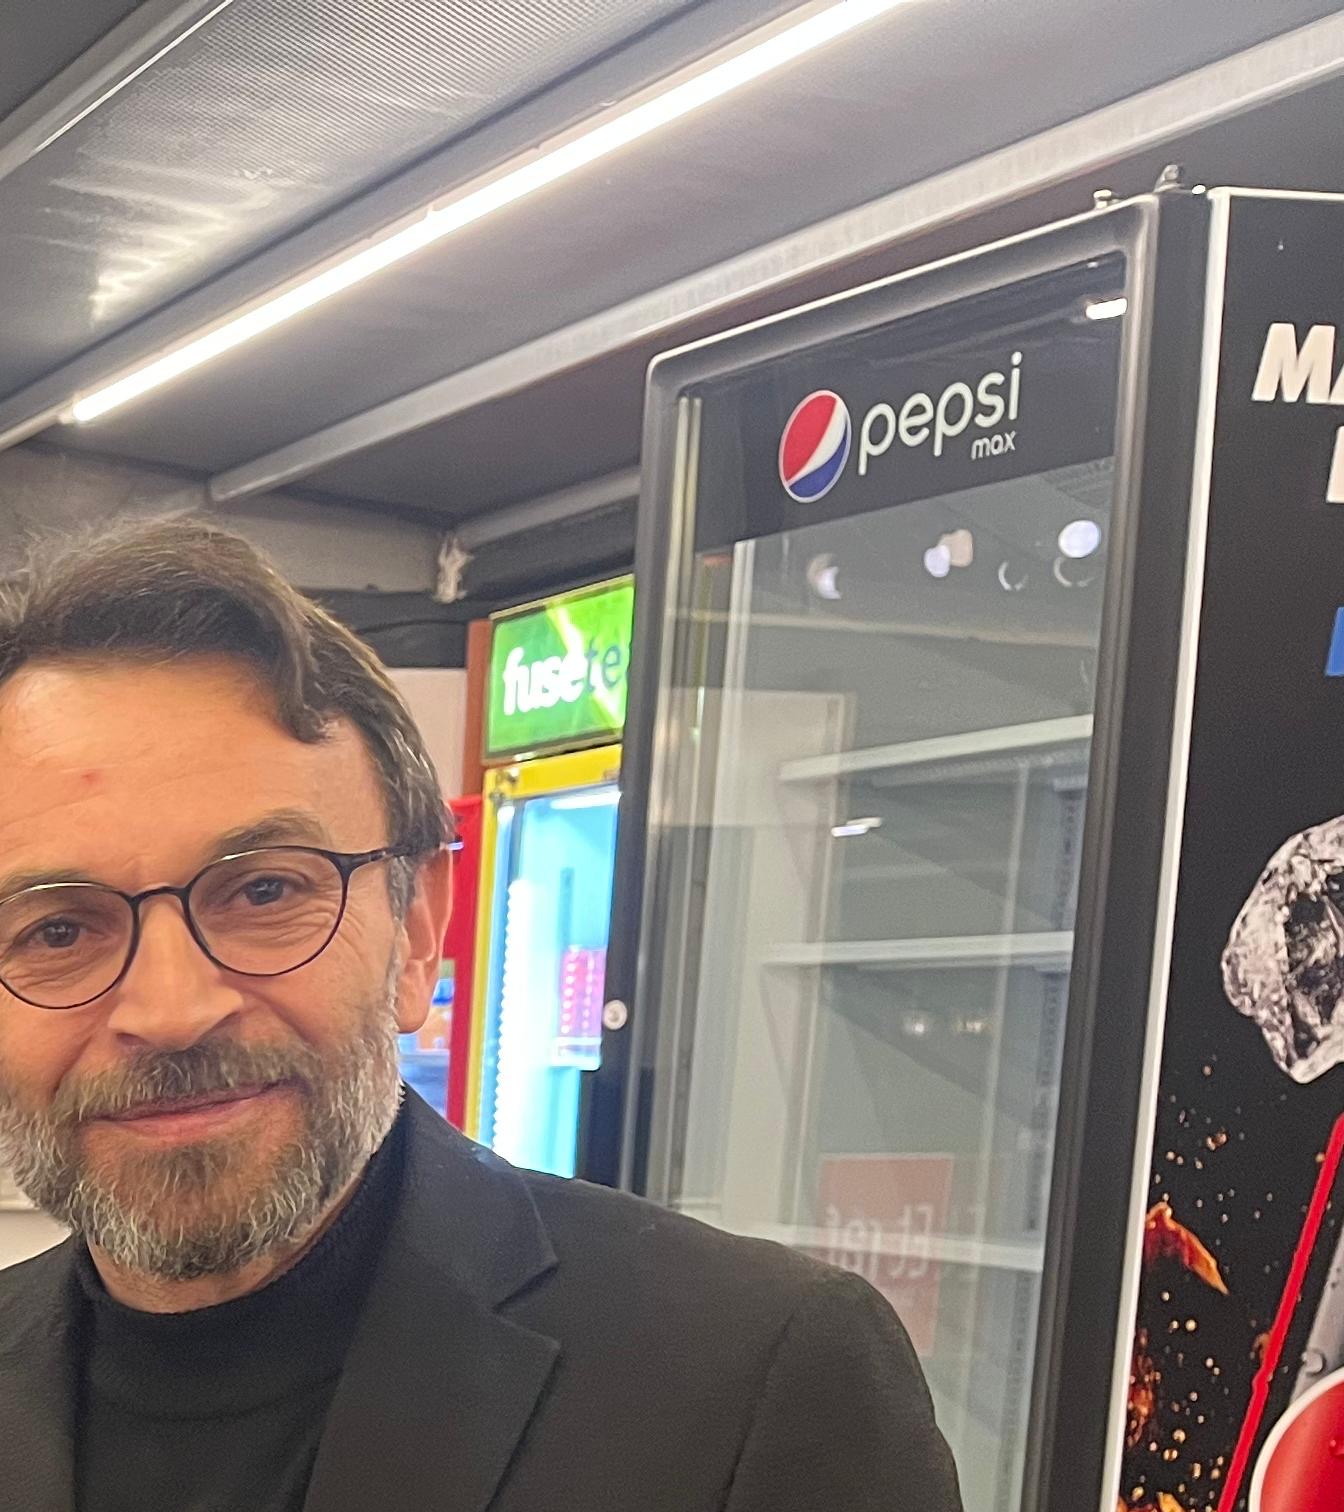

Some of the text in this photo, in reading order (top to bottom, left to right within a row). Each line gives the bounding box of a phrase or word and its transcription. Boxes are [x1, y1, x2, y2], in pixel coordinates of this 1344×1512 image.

[858, 351, 1023, 476] pepsi
[971, 430, 1016, 460] max
[502, 637, 628, 716] fusete
